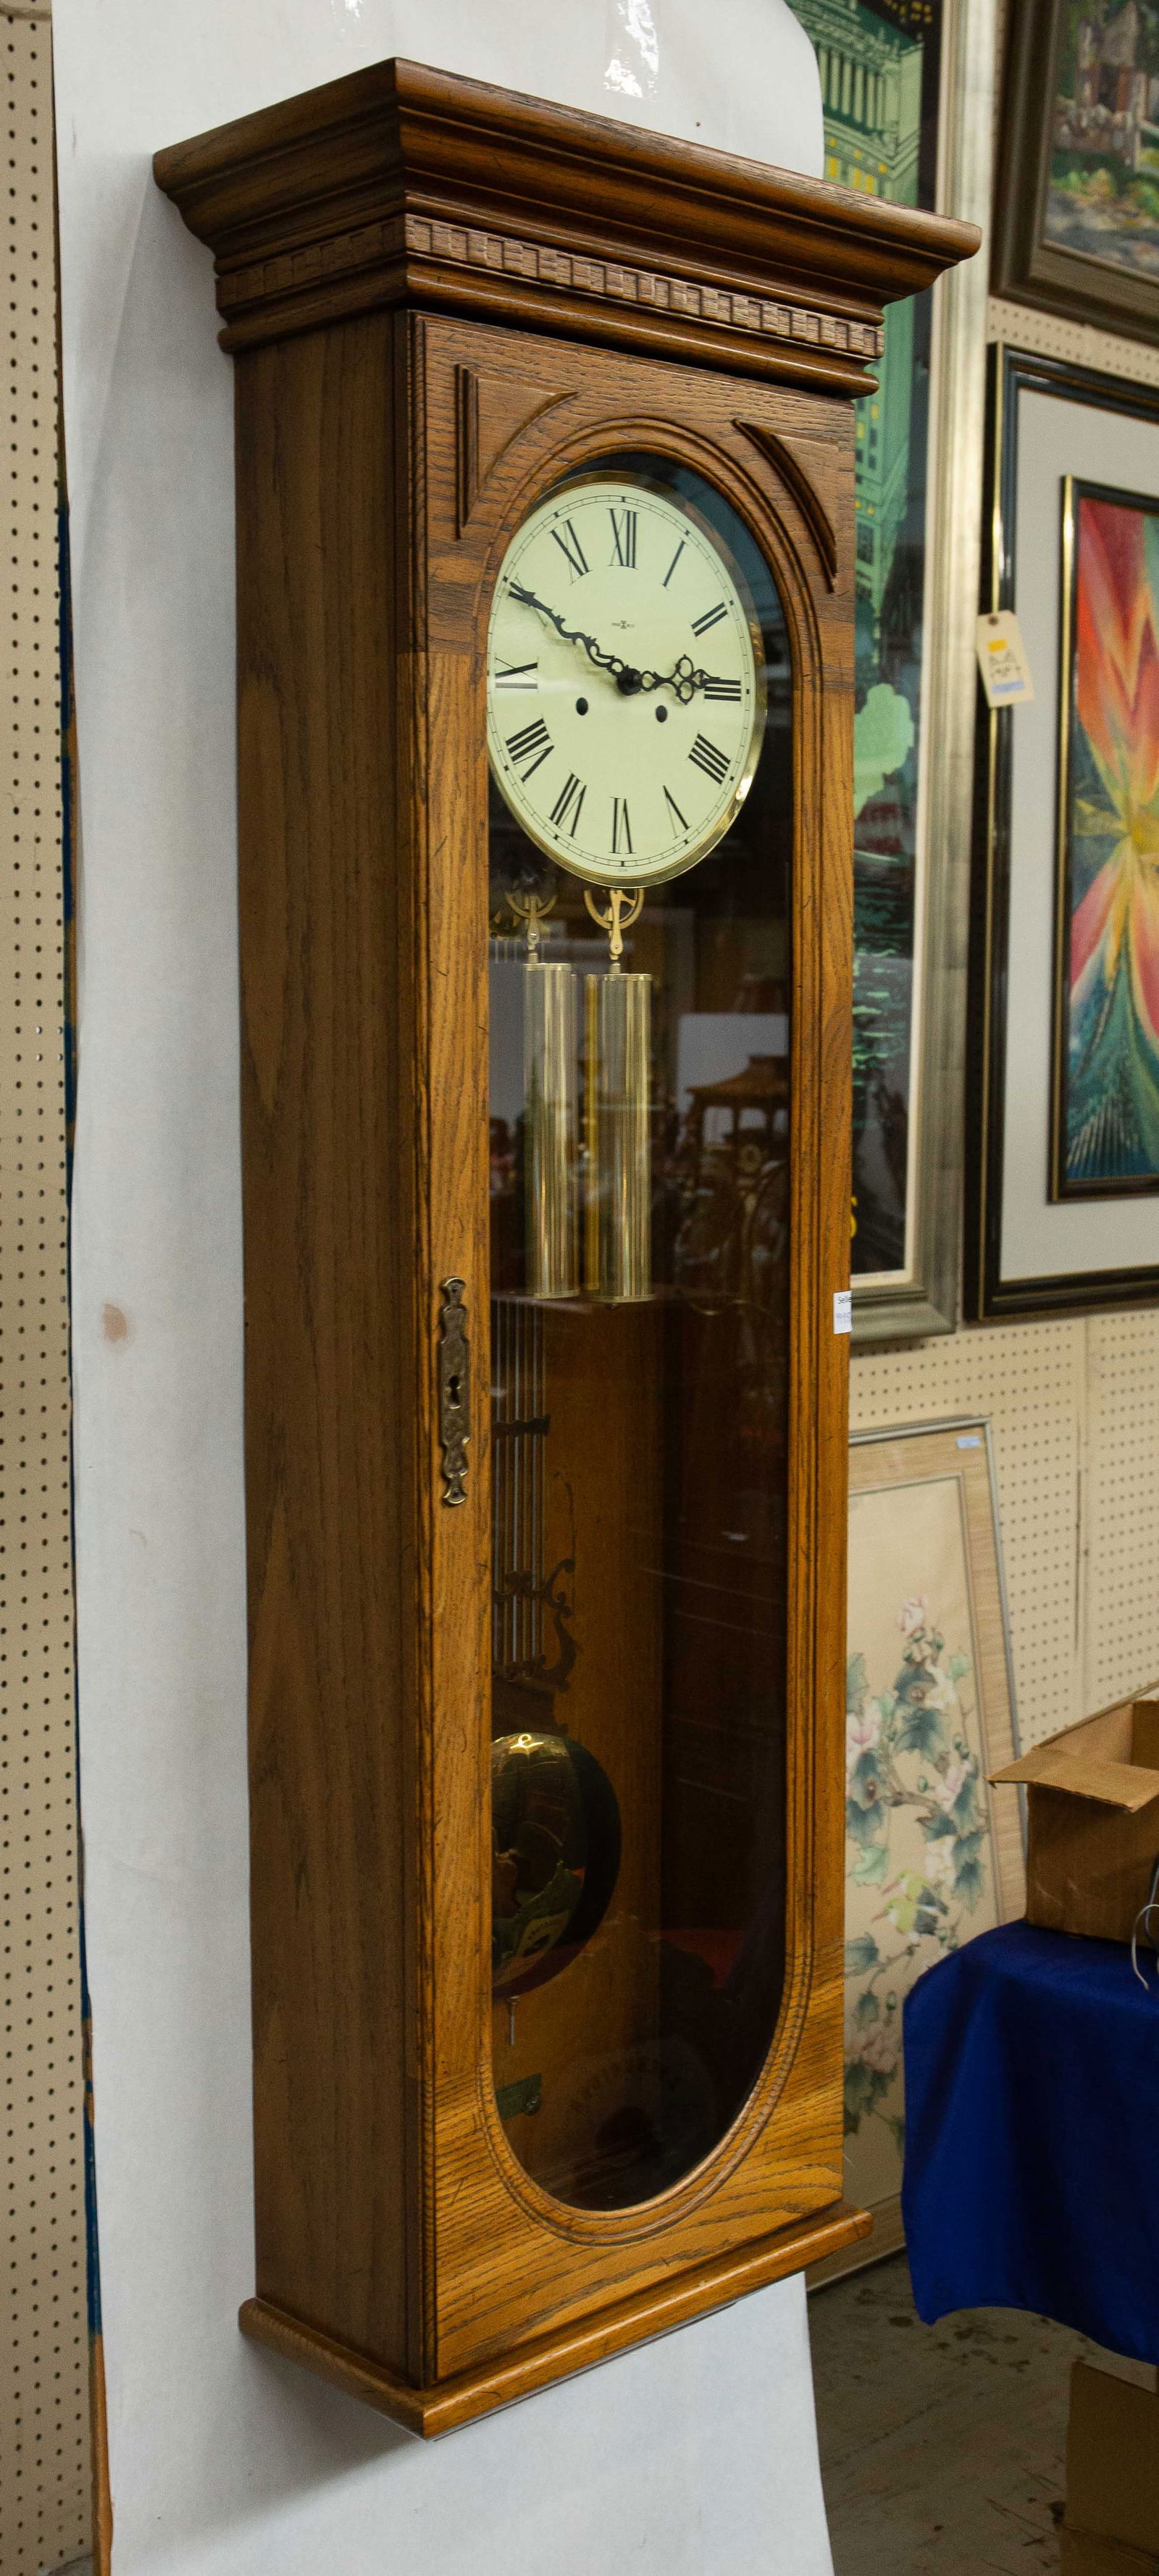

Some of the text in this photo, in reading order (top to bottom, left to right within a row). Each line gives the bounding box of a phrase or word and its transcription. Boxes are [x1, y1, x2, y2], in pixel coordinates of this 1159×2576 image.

[548, 517, 593, 586] XI
[606, 508, 640, 570] XII
[662, 537, 689, 591] I
[691, 602, 728, 637] II
[495, 655, 539, 692] IX
[703, 677, 742, 702] III
[505, 715, 554, 786] VIII
[687, 732, 731, 785] IIII
[545, 770, 587, 840] VII
[608, 797, 637, 855] VI
[663, 784, 692, 840] V
